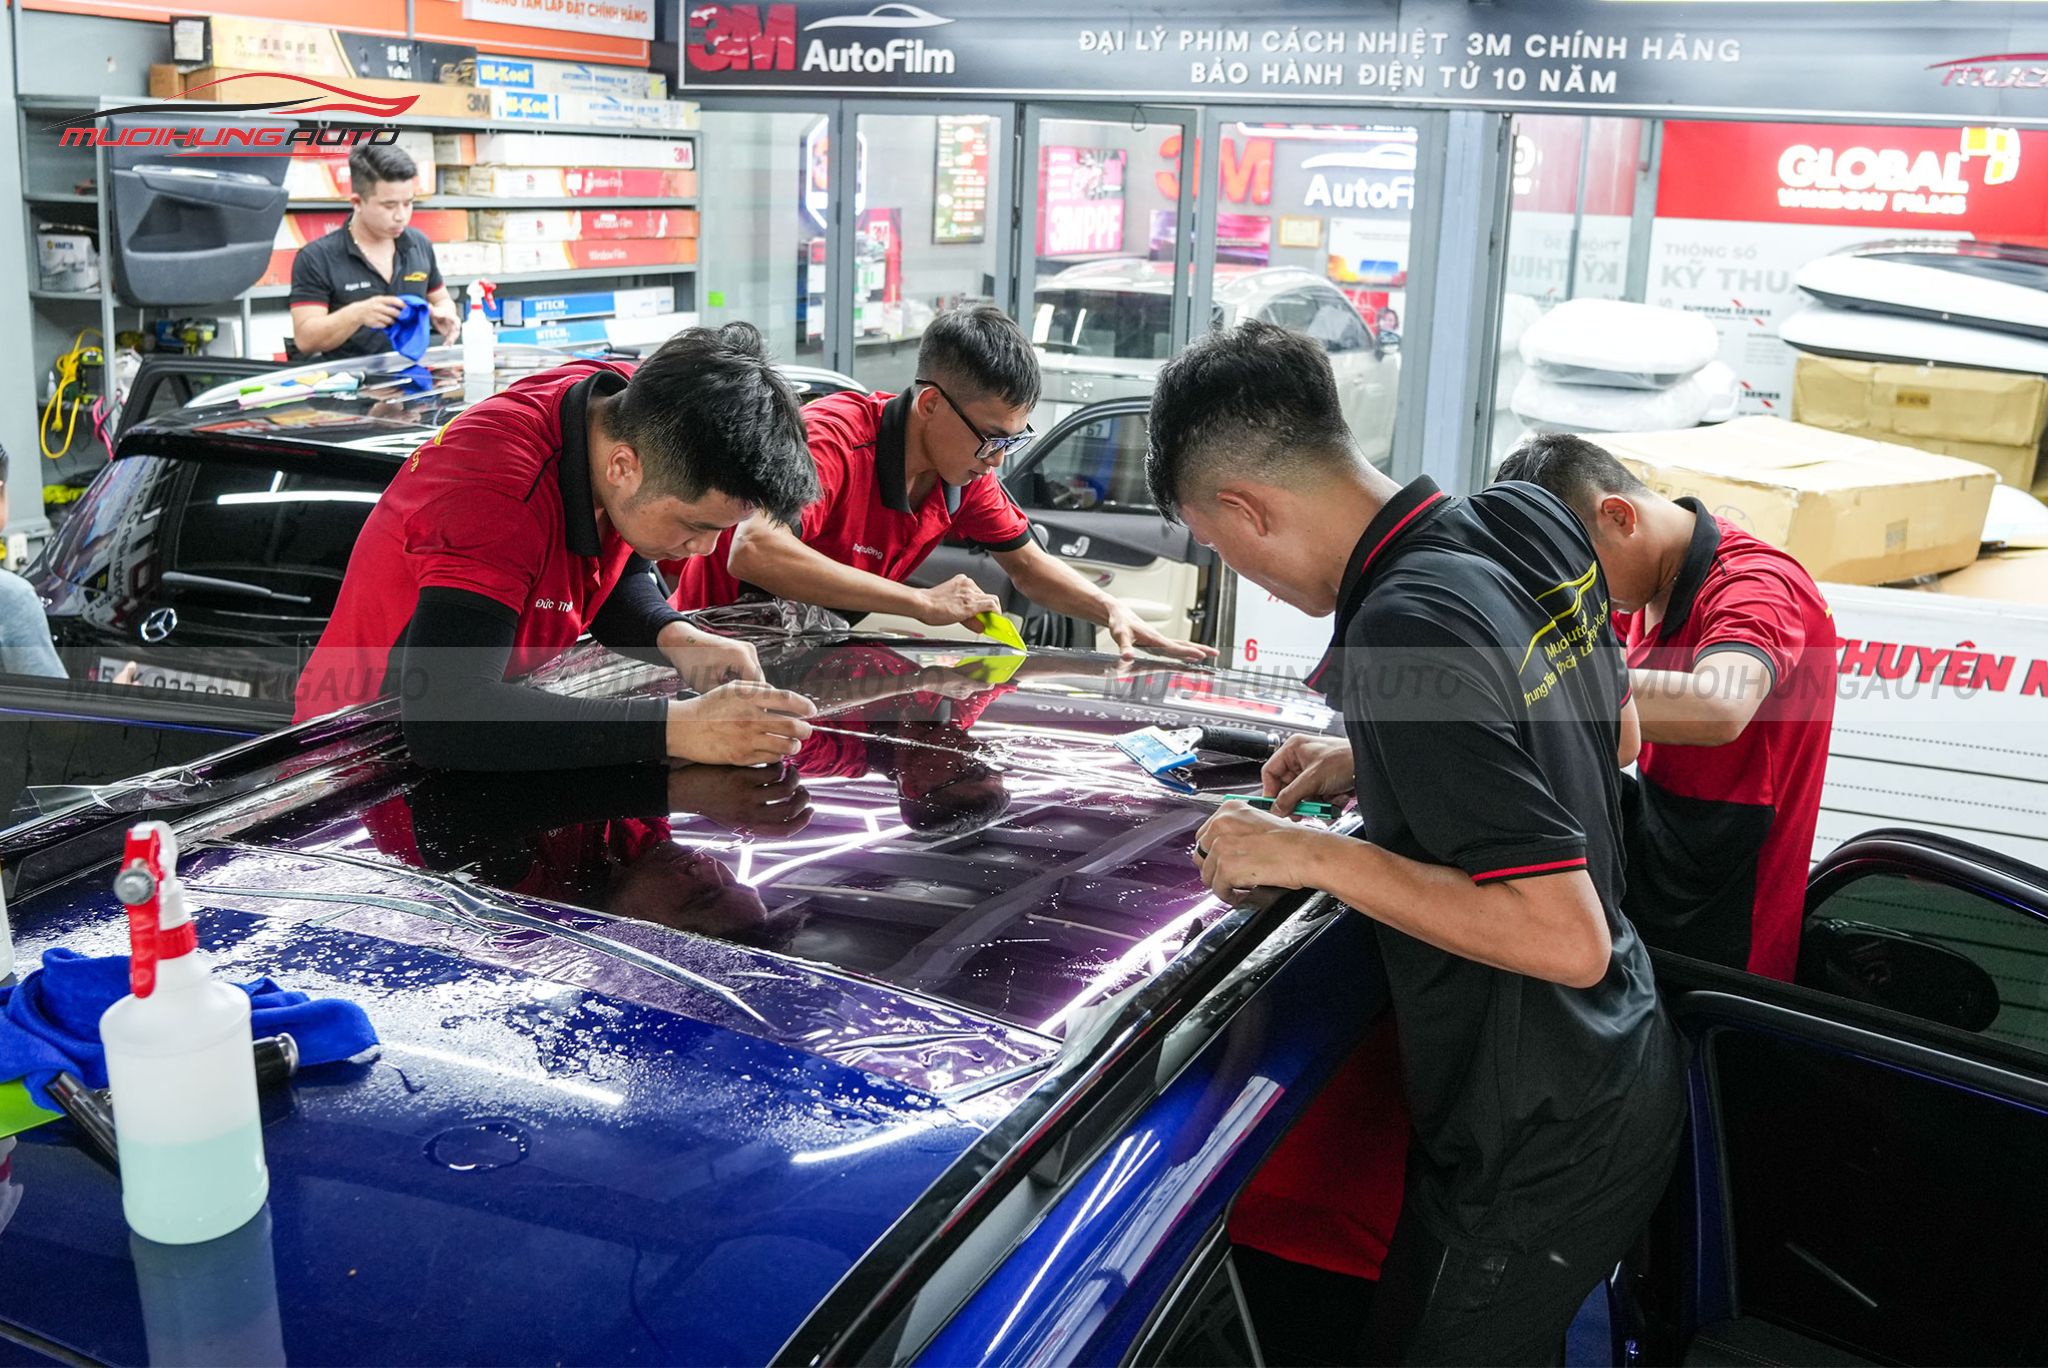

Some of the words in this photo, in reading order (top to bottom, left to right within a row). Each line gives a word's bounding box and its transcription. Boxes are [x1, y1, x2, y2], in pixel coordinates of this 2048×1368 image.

[687, 2, 798, 72] 3M
[1078, 30, 1124, 55] ĐẠI
[1136, 25, 1167, 51] LÝ
[1179, 30, 1250, 51] PHIM
[1261, 26, 1345, 53] CÁCH
[1357, 28, 1448, 60] NHIỆT
[1466, 33, 1512, 57] 3M
[1524, 30, 1628, 59] CHÍNH
[1642, 33, 1742, 63] HÃNG
[802, 39, 955, 73] AutoFilm
[1191, 57, 1249, 84] BẢO
[1261, 58, 1344, 85] HÀNH
[1358, 60, 1425, 92] ĐIỆN
[1439, 60, 1481, 90] TỬ
[1492, 67, 1527, 91] 10
[1539, 64, 1618, 95] NĂM
[467, 92, 490, 115] 3M
[673, 147, 690, 163] 3M
[1777, 144, 1969, 194] GLOBAL
[1665, 241, 1727, 259] THÔNG
[1660, 258, 1706, 289] KỸ
[1244, 638, 1258, 663] 6
